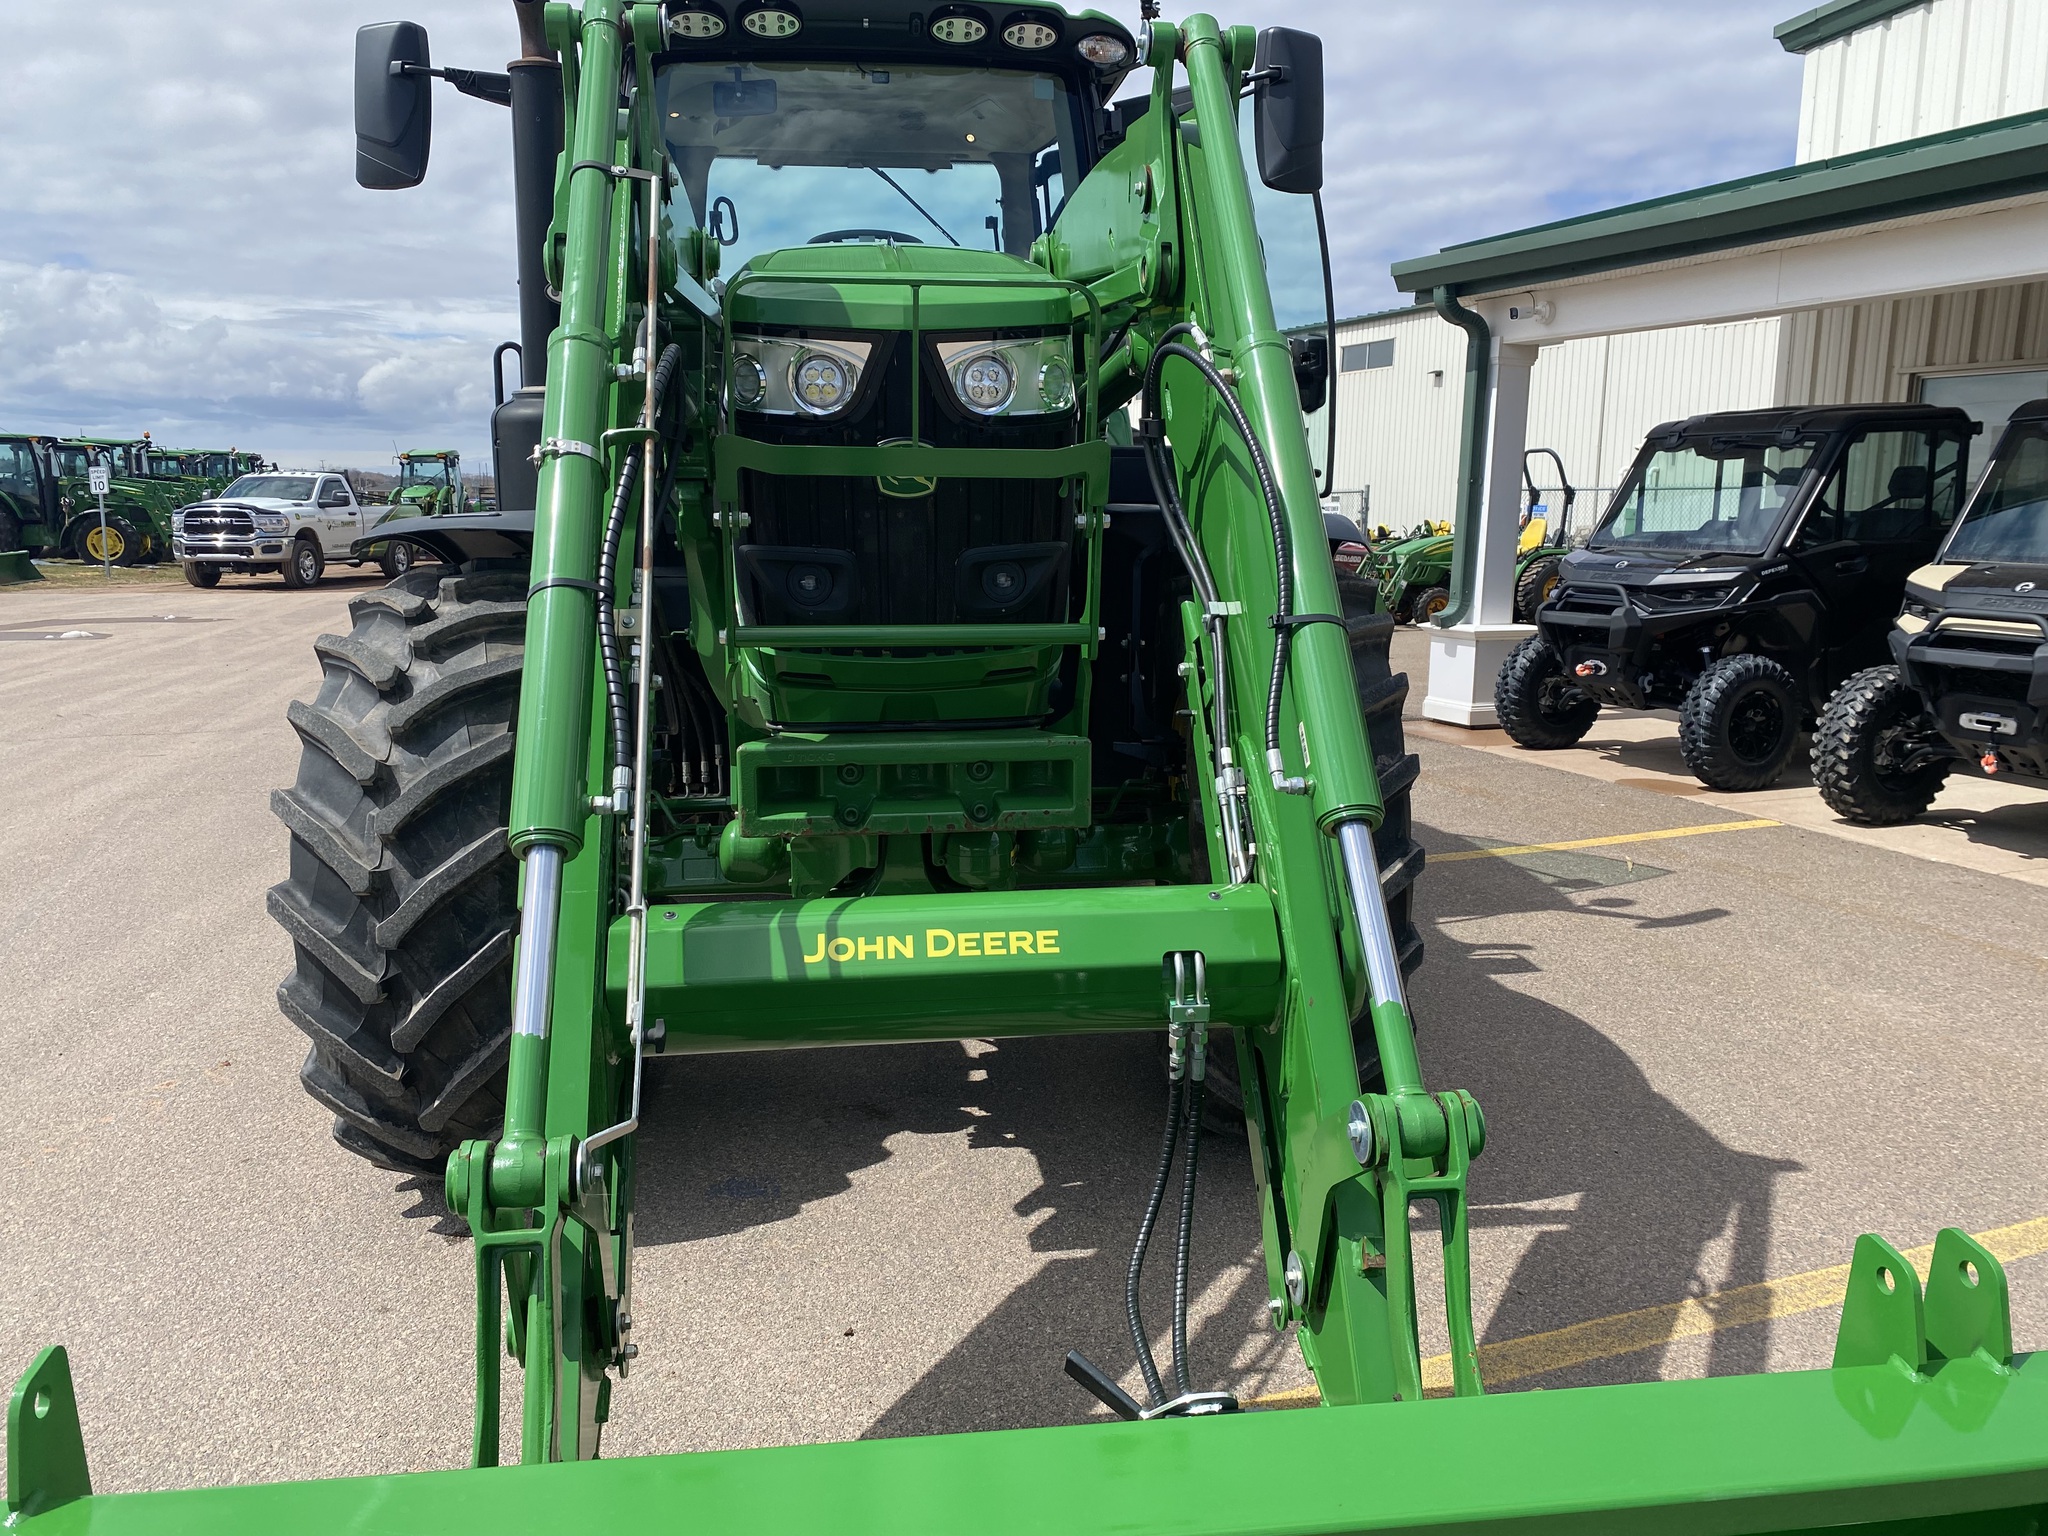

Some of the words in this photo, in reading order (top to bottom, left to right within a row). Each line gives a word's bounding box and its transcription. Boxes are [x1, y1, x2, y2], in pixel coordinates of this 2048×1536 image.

[93, 481, 105, 491] 10
[803, 933, 914, 963] JOHN
[926, 929, 1060, 958] DEERE
